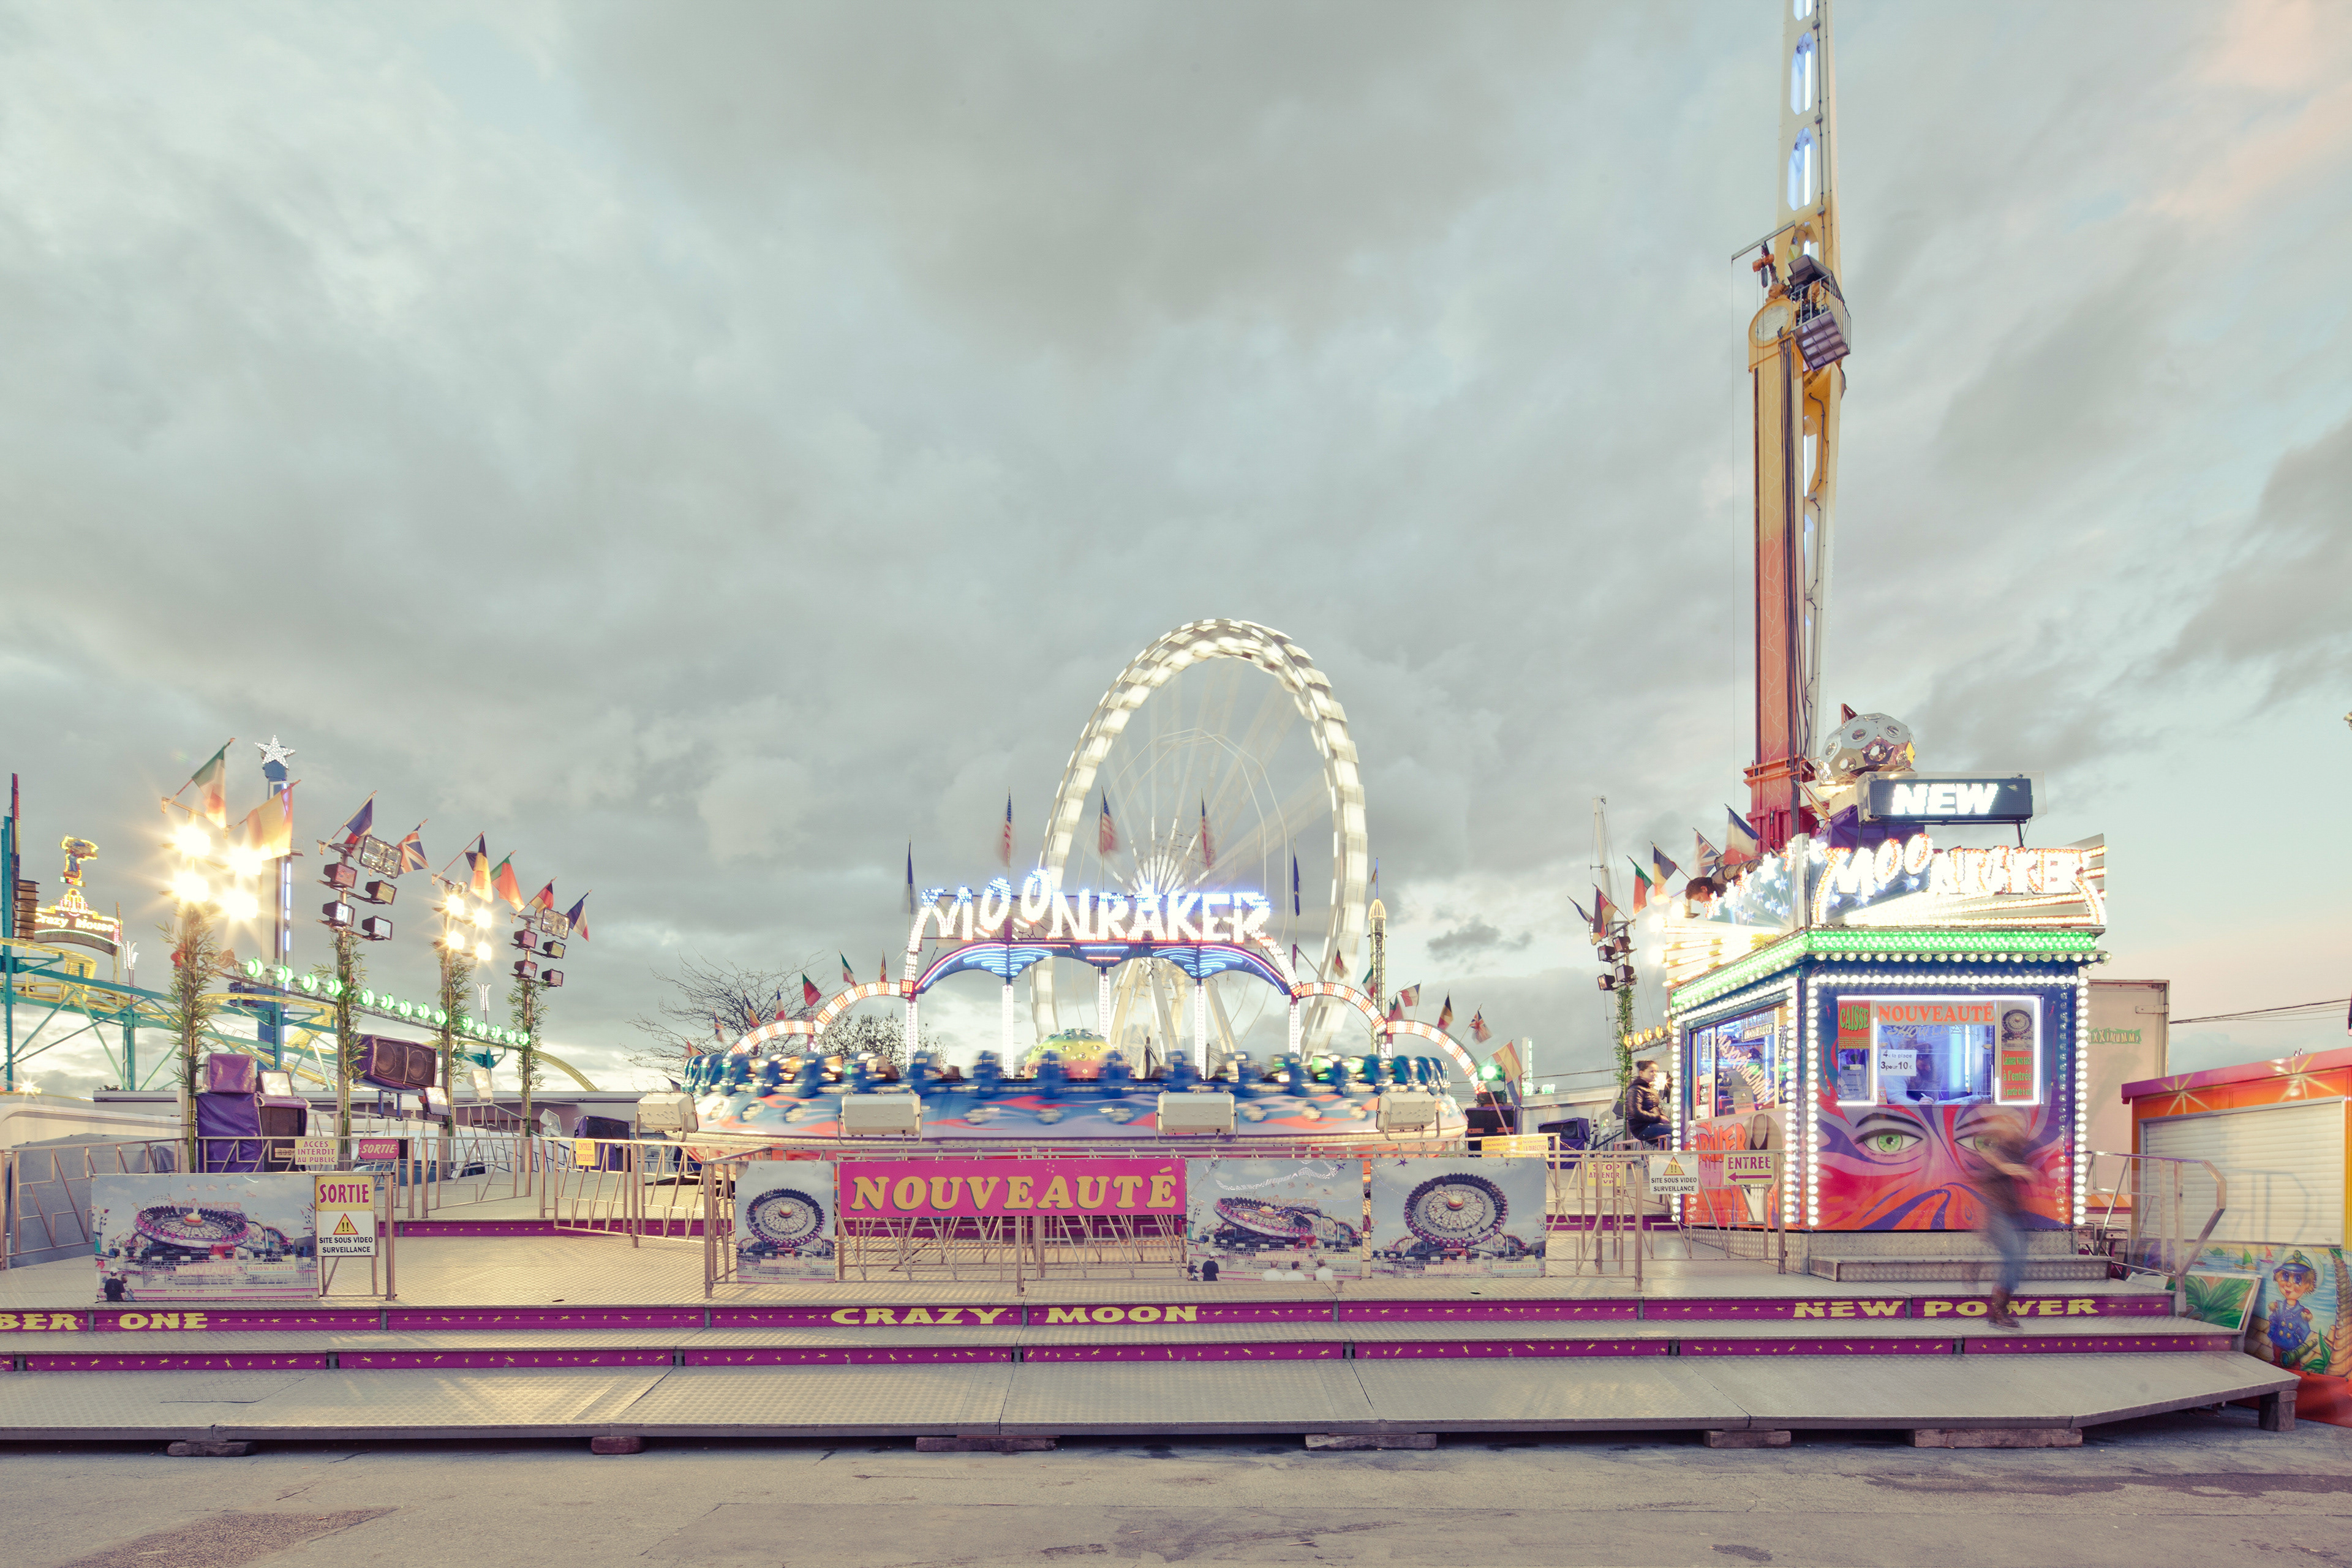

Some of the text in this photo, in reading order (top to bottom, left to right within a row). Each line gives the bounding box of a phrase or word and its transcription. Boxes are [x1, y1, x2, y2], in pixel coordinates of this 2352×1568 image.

[1891, 783, 1999, 815] NEW
[911, 869, 1272, 943] MOONRAKER
[1839, 1005, 1869, 1031] CAISSE
[1878, 1001, 1995, 1022] NOUVEAUTÉ
[2008, 1069, 2032, 1081] l'entrée
[361, 1144, 397, 1155] SORTIE
[1728, 1156, 1771, 1170] ENTREE
[319, 1183, 369, 1204] SORTIE
[850, 1166, 1176, 1210] NOUVEAUTÉ
[831, 1305, 1198, 1325] CRAZY MOON
[1793, 1301, 1904, 1318] NEW
[119, 1313, 208, 1330] ONE
